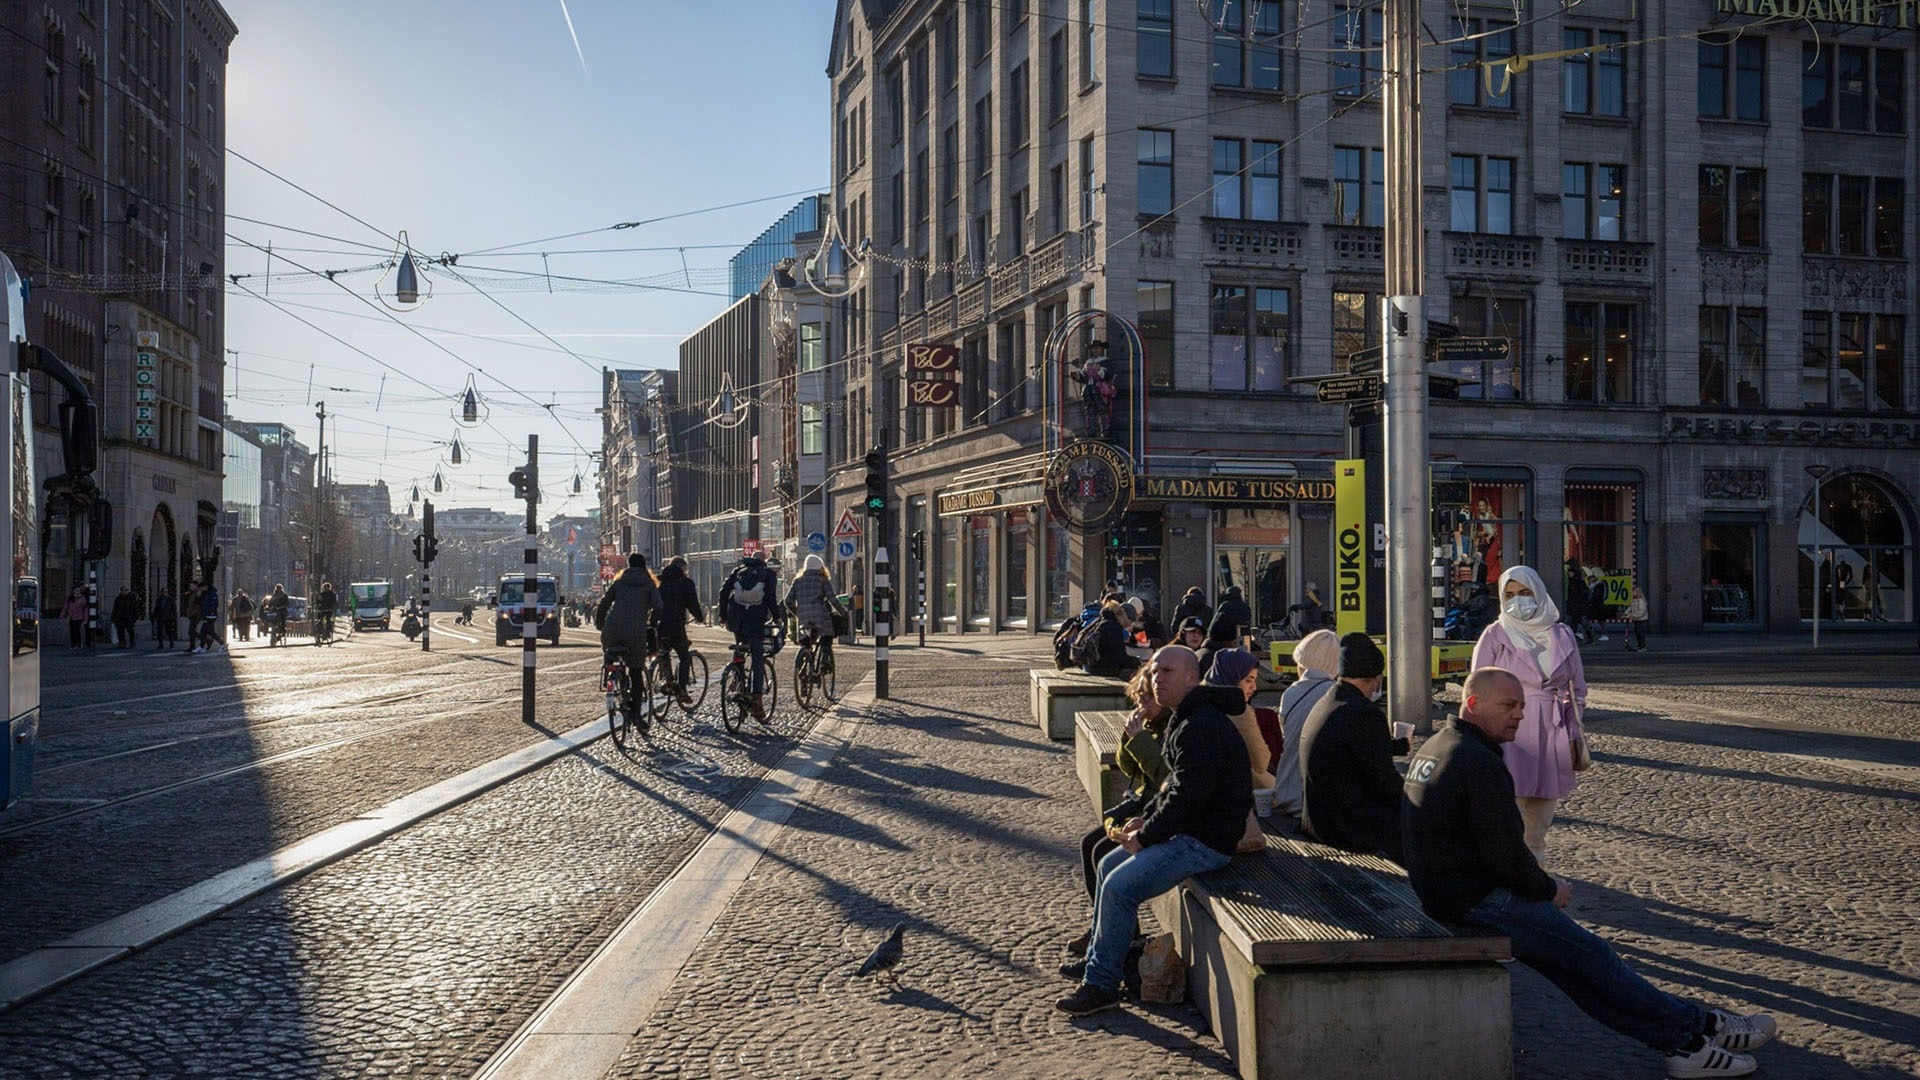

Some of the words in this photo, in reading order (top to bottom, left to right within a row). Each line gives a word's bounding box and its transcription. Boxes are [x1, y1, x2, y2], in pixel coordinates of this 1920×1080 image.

[1897, 0, 1920, 28] T
[910, 346, 954, 369] P&C
[138, 353, 150, 437] ROLEX
[910, 381, 954, 404] P&C
[1147, 479, 1239, 497] MADAME
[1246, 481, 1335, 499] TUSSAUD
